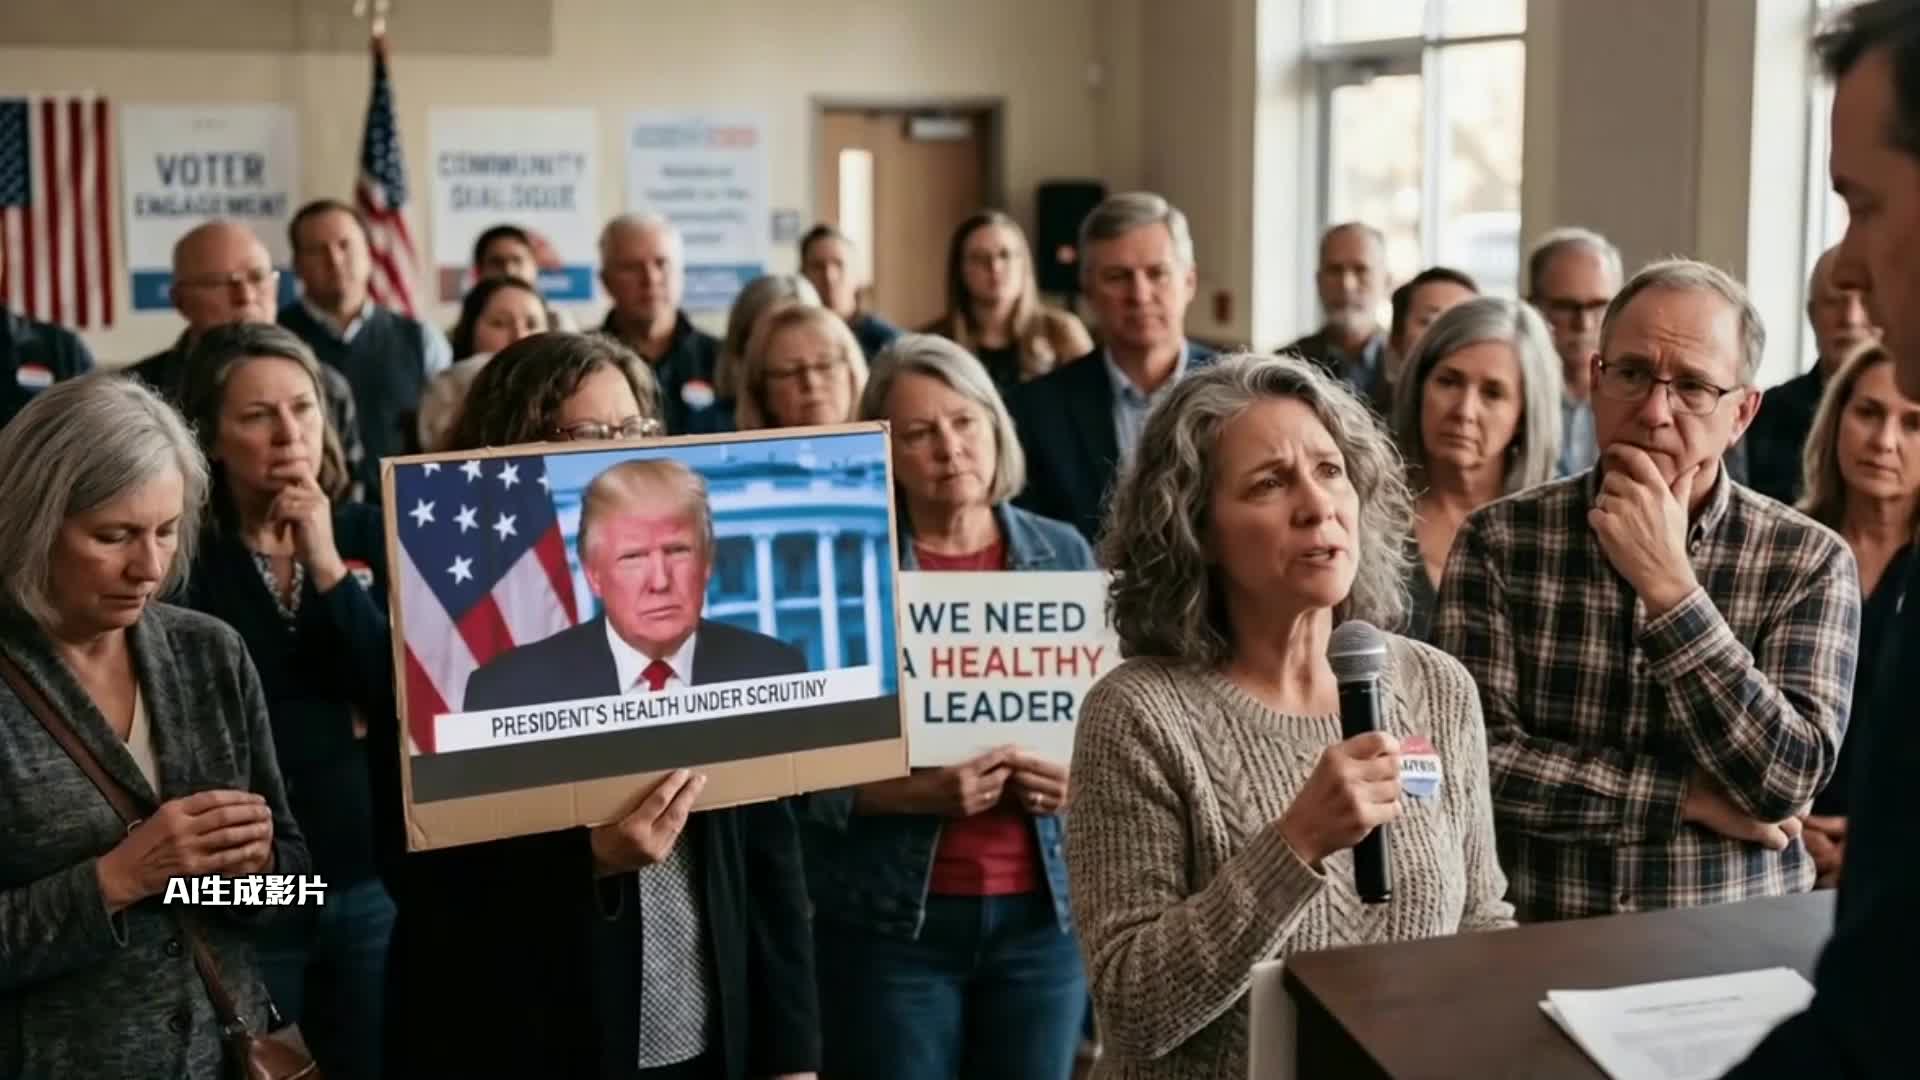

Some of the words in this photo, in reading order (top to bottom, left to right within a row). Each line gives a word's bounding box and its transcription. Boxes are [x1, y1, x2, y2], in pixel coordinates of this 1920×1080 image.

[155, 152, 265, 187] VOTER
[908, 602, 972, 634] WE
[984, 602, 1087, 633] NEED
[931, 646, 1104, 678] HEALTHY
[491, 704, 608, 738] PRESIDENT'S
[613, 696, 680, 723] HEALTH
[684, 688, 743, 713] UNDER
[746, 678, 827, 706] SCRUTINY
[924, 691, 1074, 723] LEADER
